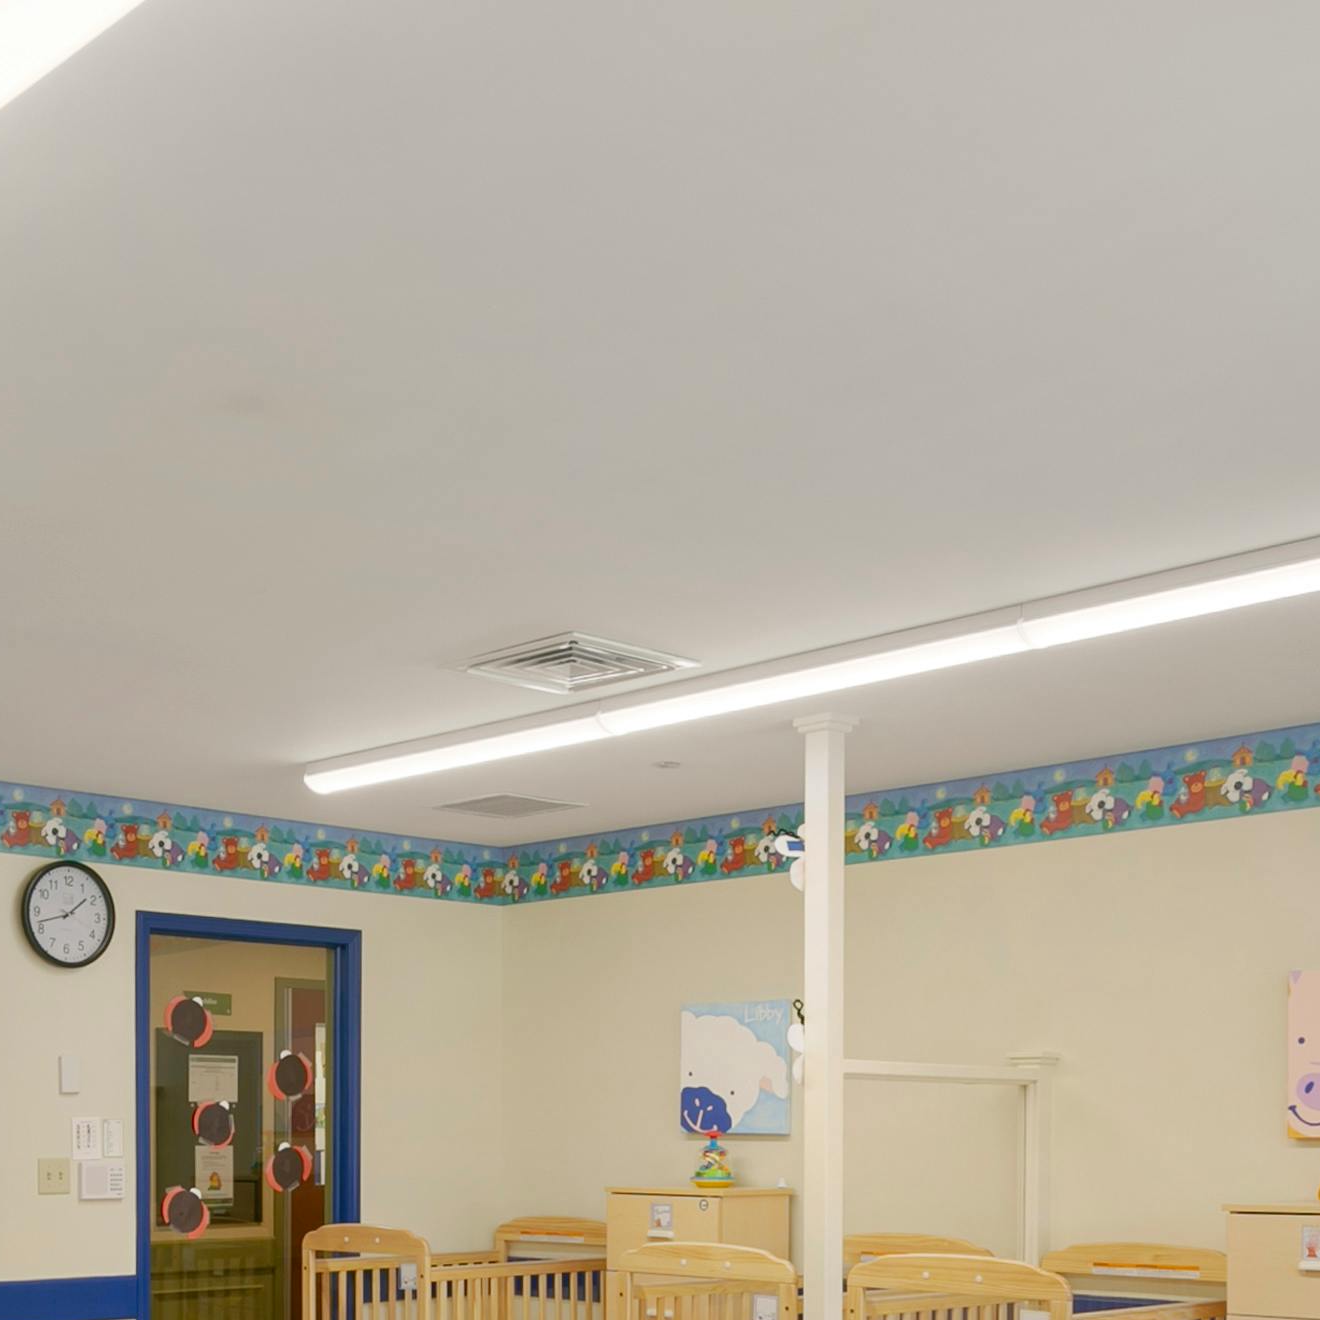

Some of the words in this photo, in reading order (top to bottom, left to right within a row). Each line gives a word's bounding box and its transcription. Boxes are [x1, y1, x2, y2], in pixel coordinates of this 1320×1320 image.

[49, 879, 58, 890] 11
[63, 875, 74, 887] 12
[38, 888, 50, 900] 10
[80, 883, 85, 894] 1
[89, 895, 97, 906] 2
[33, 905, 41, 917] 9
[94, 912, 101, 924] 3
[37, 923, 45, 934] 8
[89, 929, 96, 939] 4
[48, 937, 57, 948] 7
[77, 940, 85, 951] 5
[63, 943, 70, 954] 6
